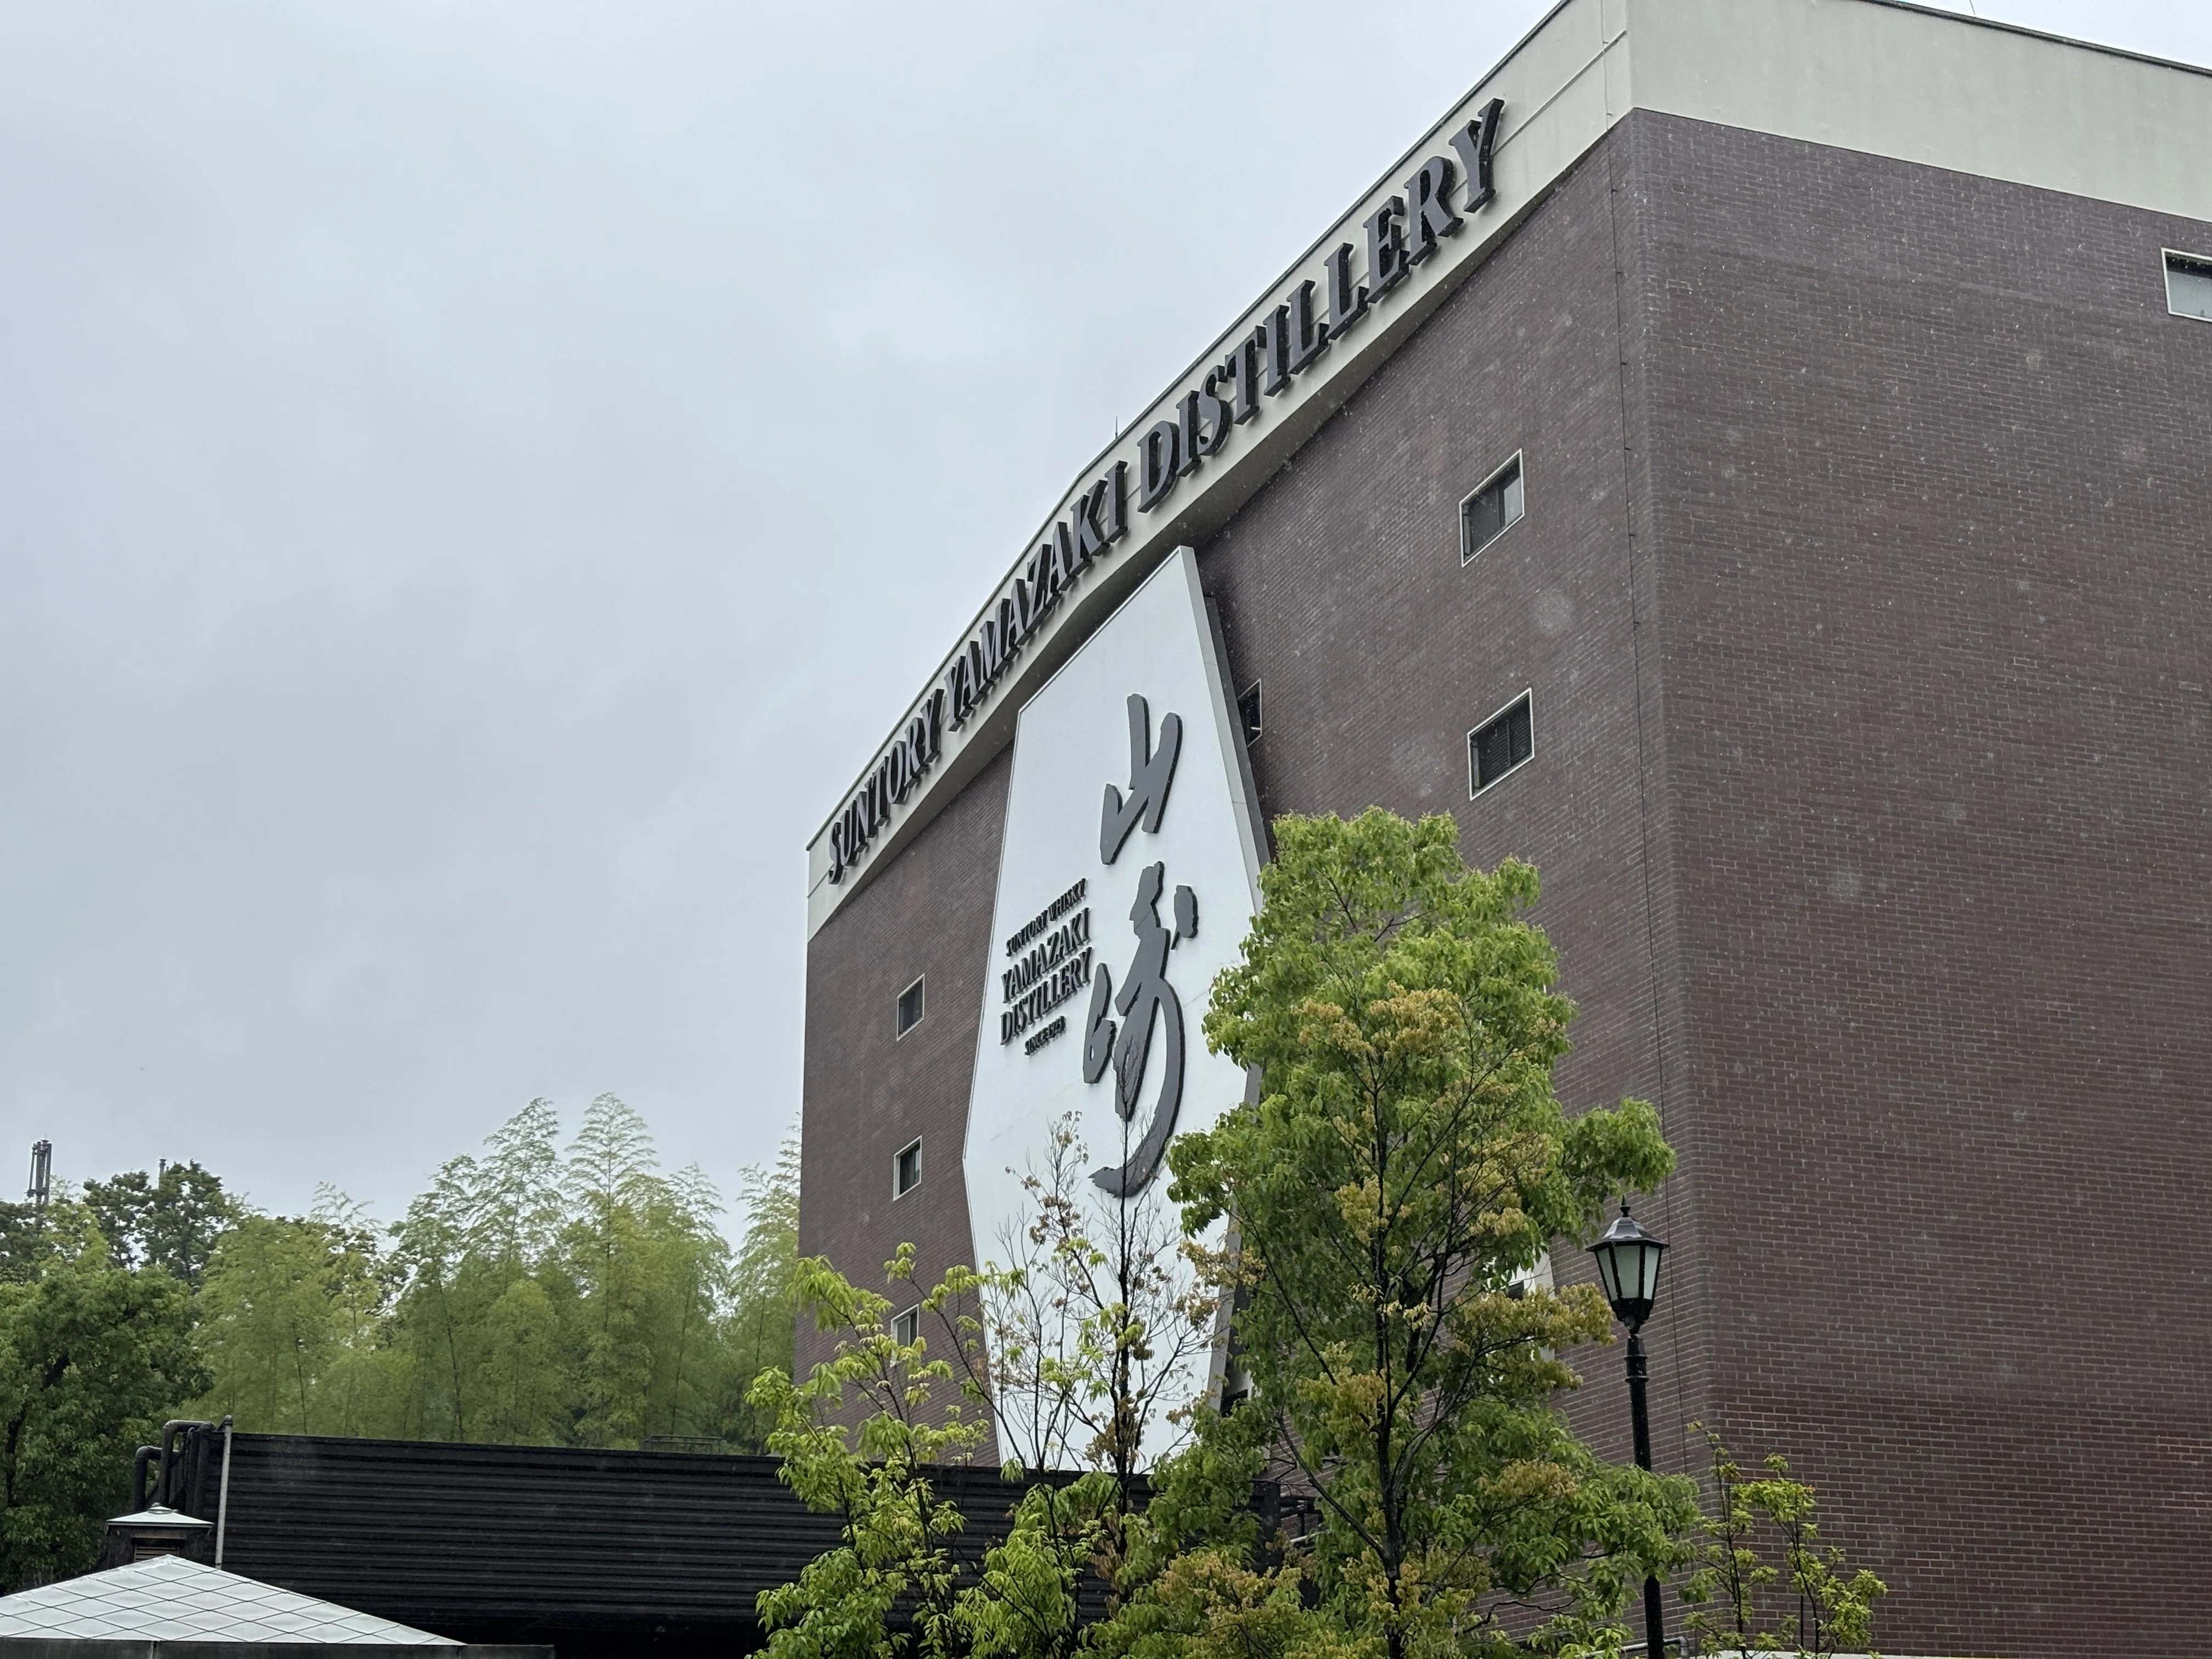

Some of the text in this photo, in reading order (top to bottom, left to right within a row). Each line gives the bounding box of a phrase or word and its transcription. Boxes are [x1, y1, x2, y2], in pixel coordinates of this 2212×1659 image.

[828, 97, 1505, 885] SUNTORY YAMAZAKI DISTILLERY
[1001, 907, 1090, 1004] YAMAZAKI
[1006, 878, 1087, 957] SUNTORY WHISKY
[1000, 946, 1093, 1046] DISTILLERY
